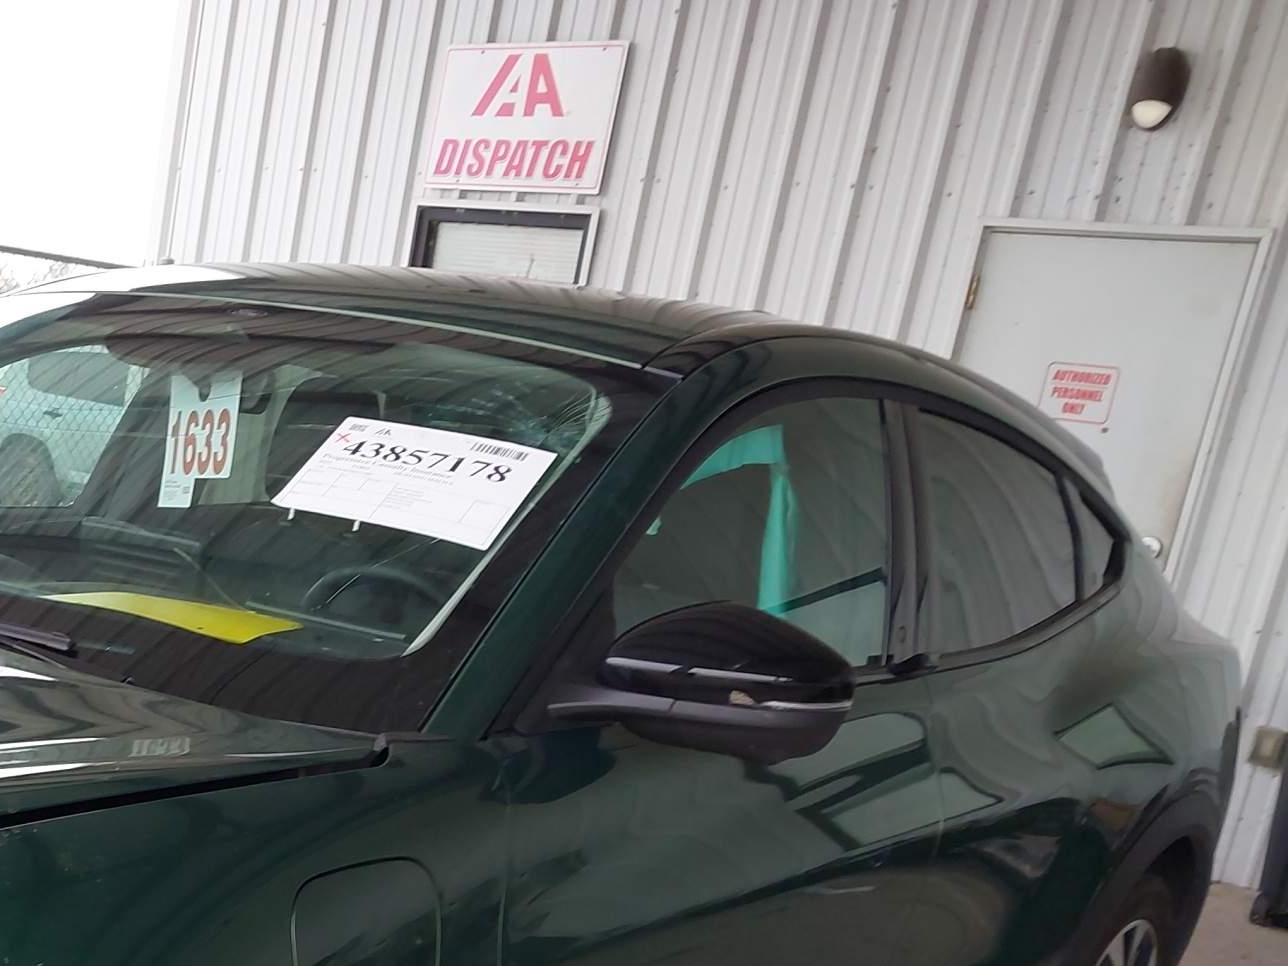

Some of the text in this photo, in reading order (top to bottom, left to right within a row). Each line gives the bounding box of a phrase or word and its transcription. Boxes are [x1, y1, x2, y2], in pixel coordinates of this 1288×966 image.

[433, 139, 594, 180] DISPATCH
[1053, 370, 1111, 385] AUTHORIZED
[1051, 386, 1103, 401] PERSONNEL
[1062, 402, 1085, 414] ONLY
[171, 408, 231, 475] 1633
[343, 441, 512, 482] 43857178
